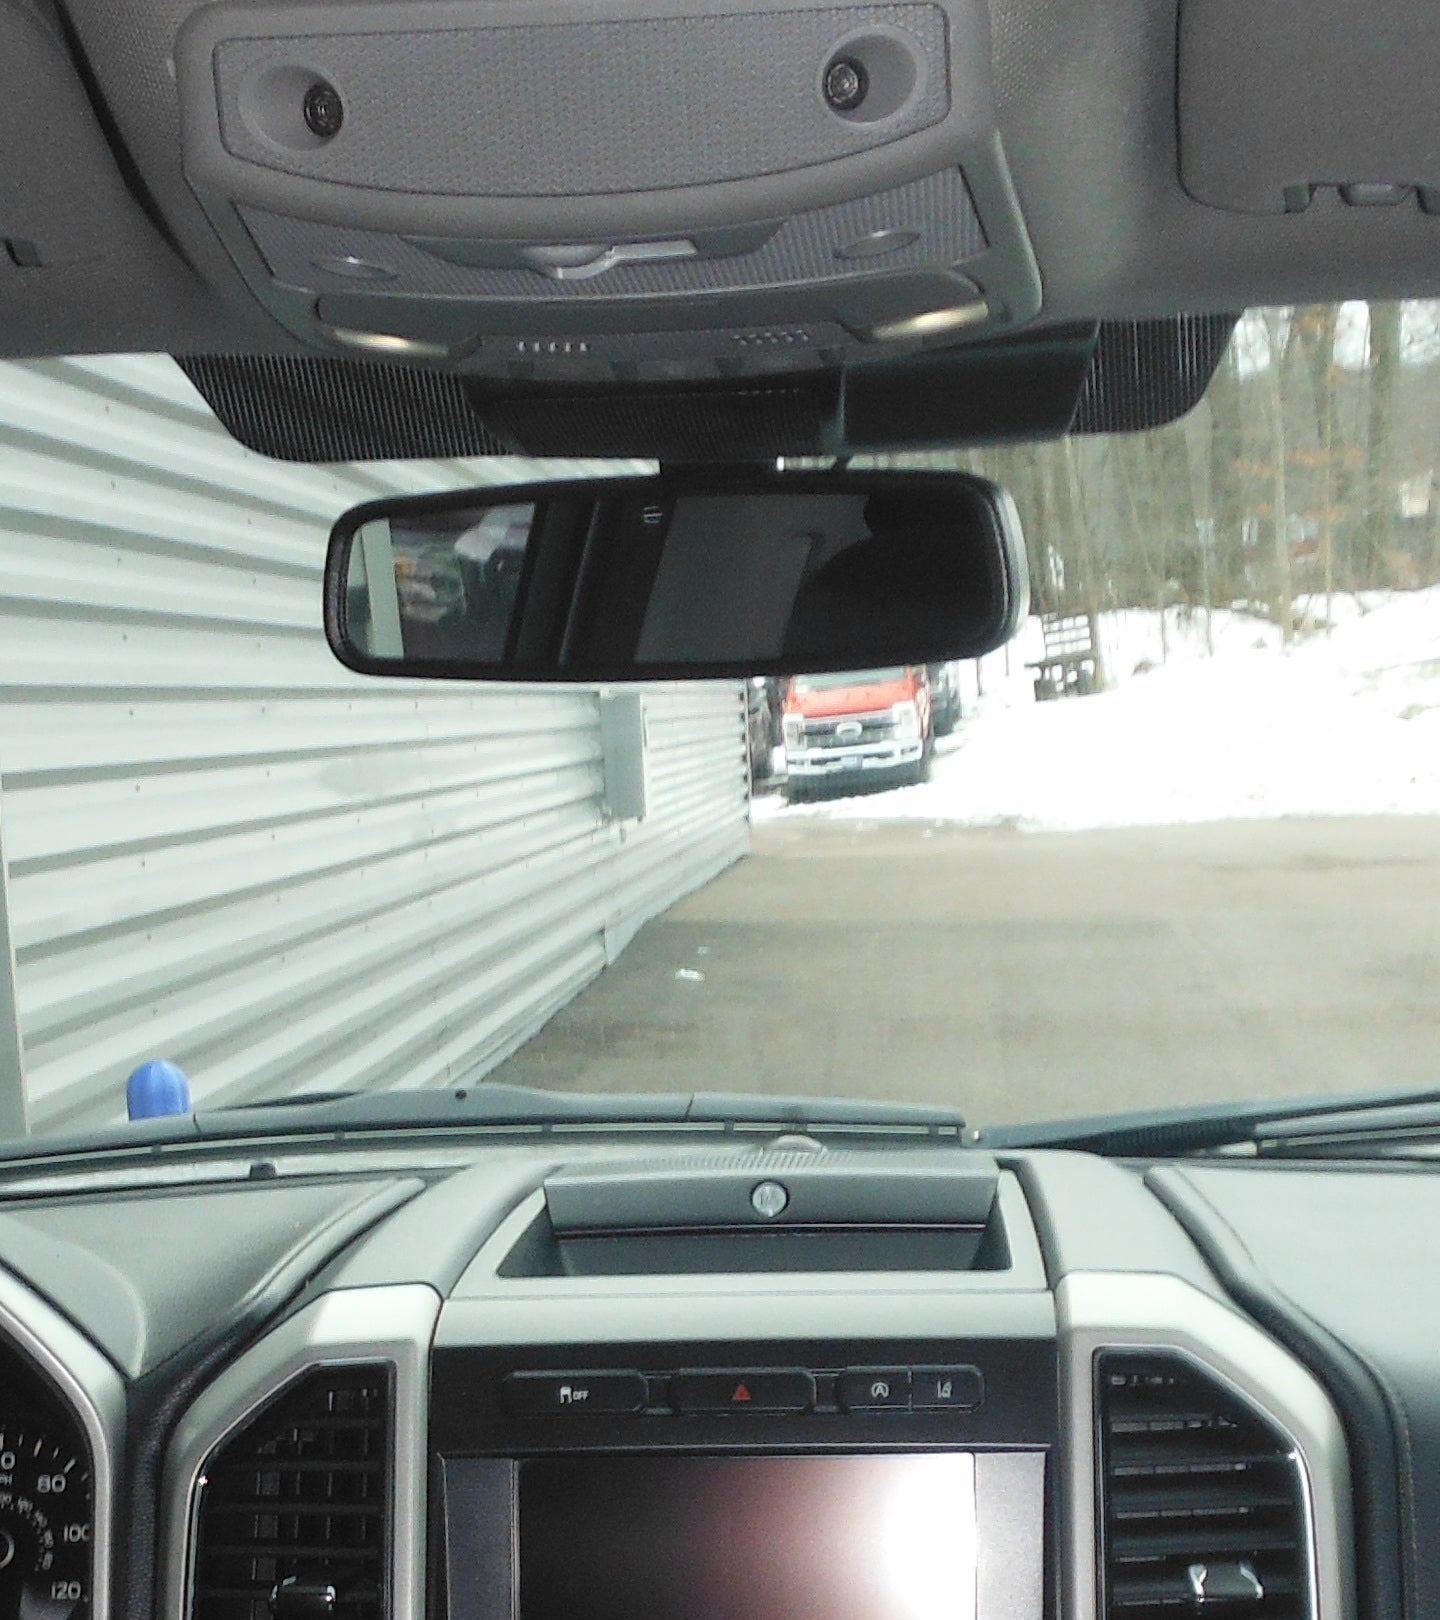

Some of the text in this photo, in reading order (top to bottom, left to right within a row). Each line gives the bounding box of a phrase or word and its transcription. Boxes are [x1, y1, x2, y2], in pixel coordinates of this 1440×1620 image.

[573, 1389, 589, 1401] OFF
[36, 1474, 67, 1493] 80
[50, 1581, 82, 1600] 120
